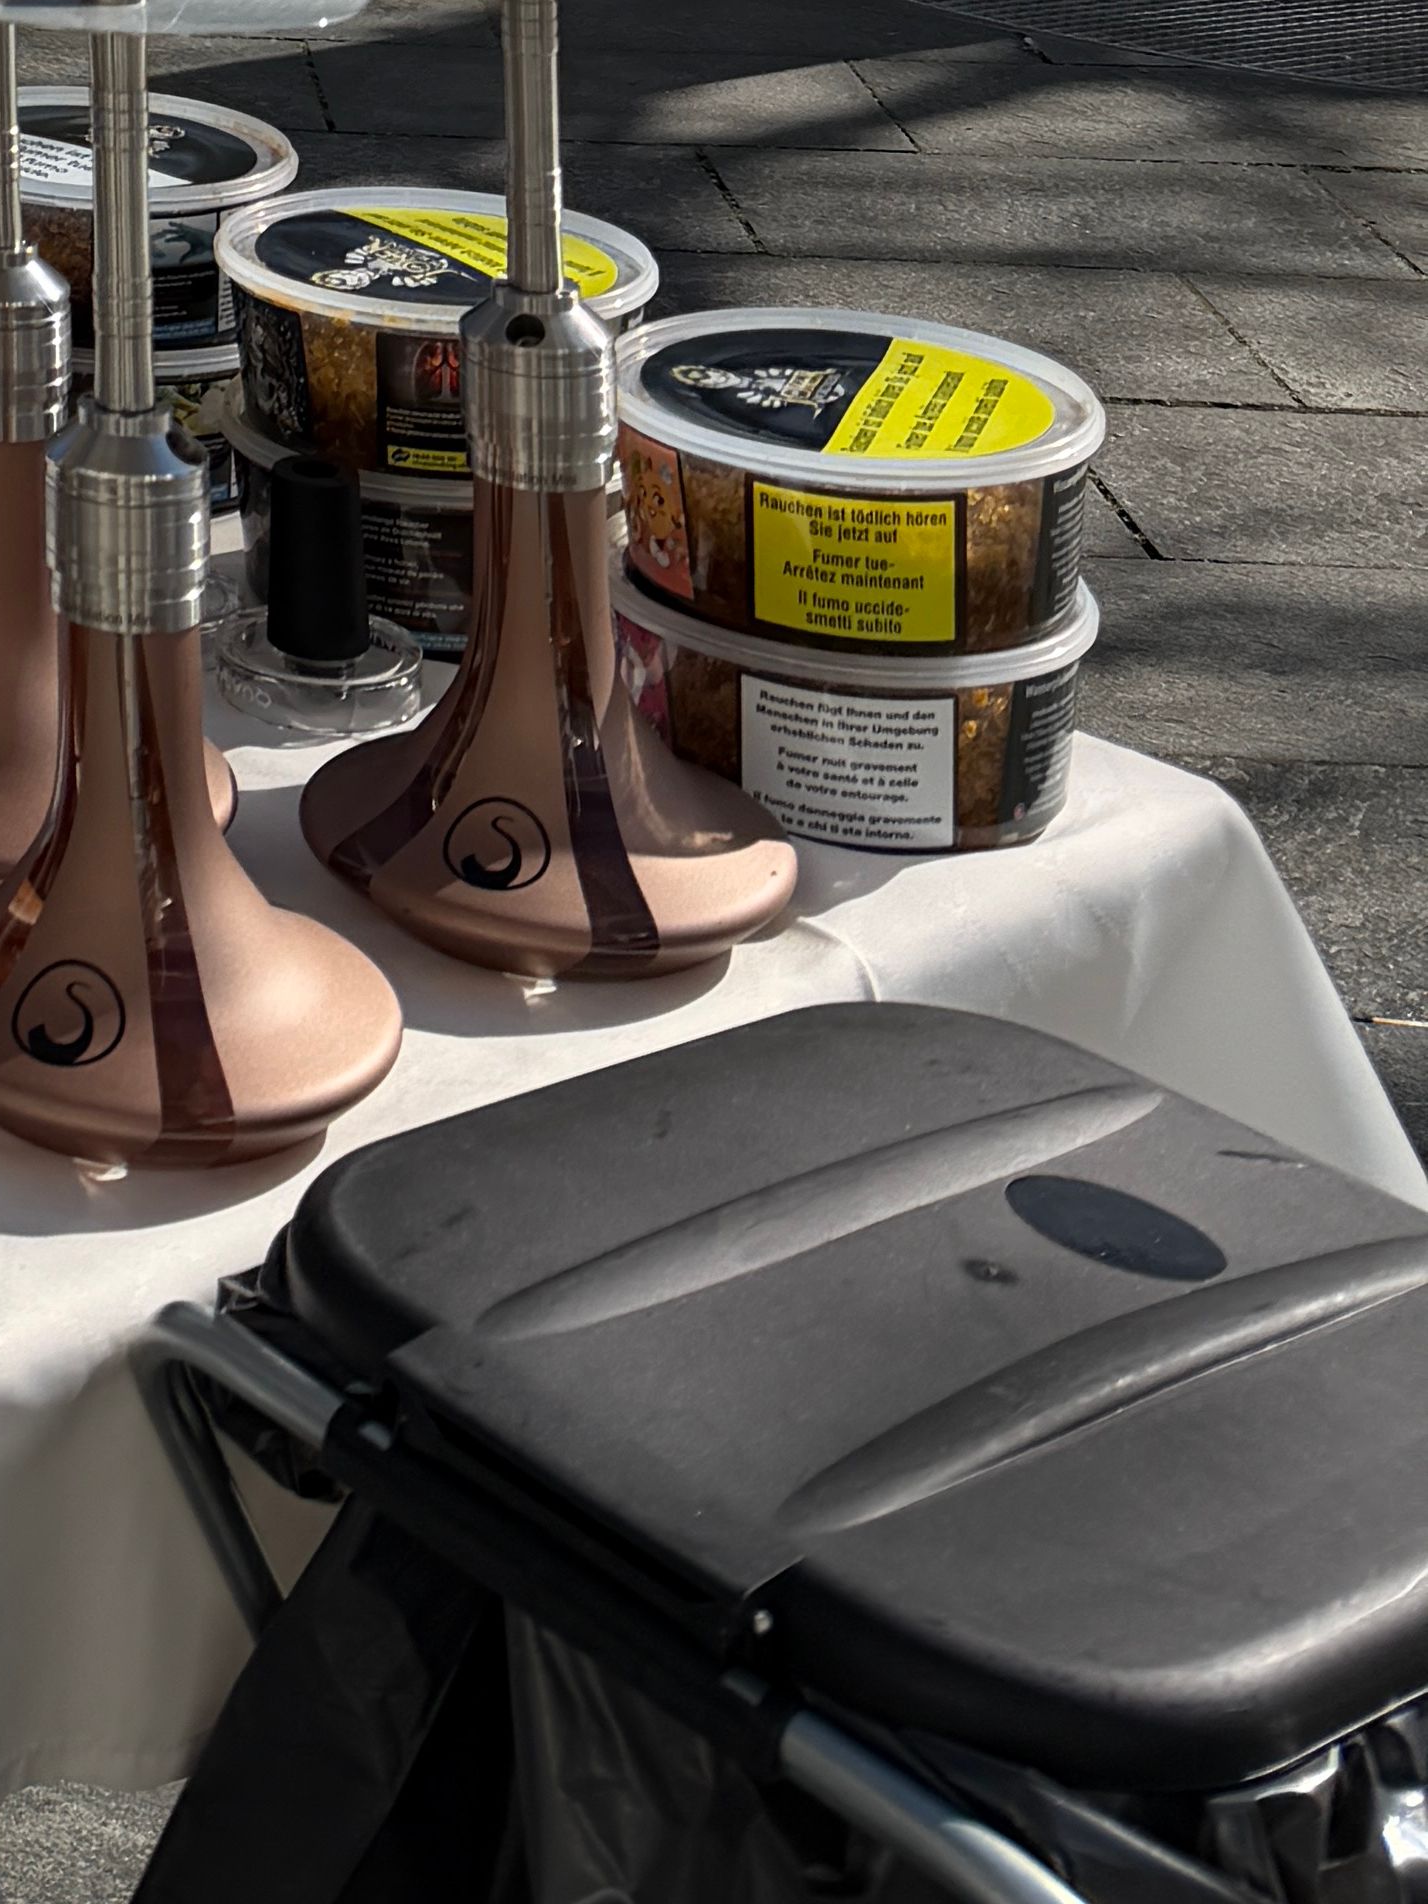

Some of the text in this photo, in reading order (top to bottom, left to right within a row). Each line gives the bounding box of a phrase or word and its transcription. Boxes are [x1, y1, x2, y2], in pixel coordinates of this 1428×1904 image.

[759, 492, 947, 527] Rauchen ist tödlich hören
[809, 520, 897, 544] Sie jetzt auf
[813, 548, 860, 570] Fumer
[783, 561, 924, 590] Arrêtez maintenant
[813, 592, 849, 612] fumo
[806, 610, 902, 634] smetti subito
[760, 690, 935, 721] Rauchen fügt Ihnen und den
[756, 703, 939, 737] Menschen in Ihrer Umgebung
[771, 723, 925, 751] erheblichen Schaden zu.
[778, 746, 917, 773] Fumer nuit gravement
[776, 761, 919, 788] à votre santé et à celle
[786, 778, 909, 803] de votre entourage.
[764, 794, 795, 810] fumo
[798, 803, 865, 823] danneggia
[868, 814, 942, 826] gravemente
[808, 820, 827, 833] chi
